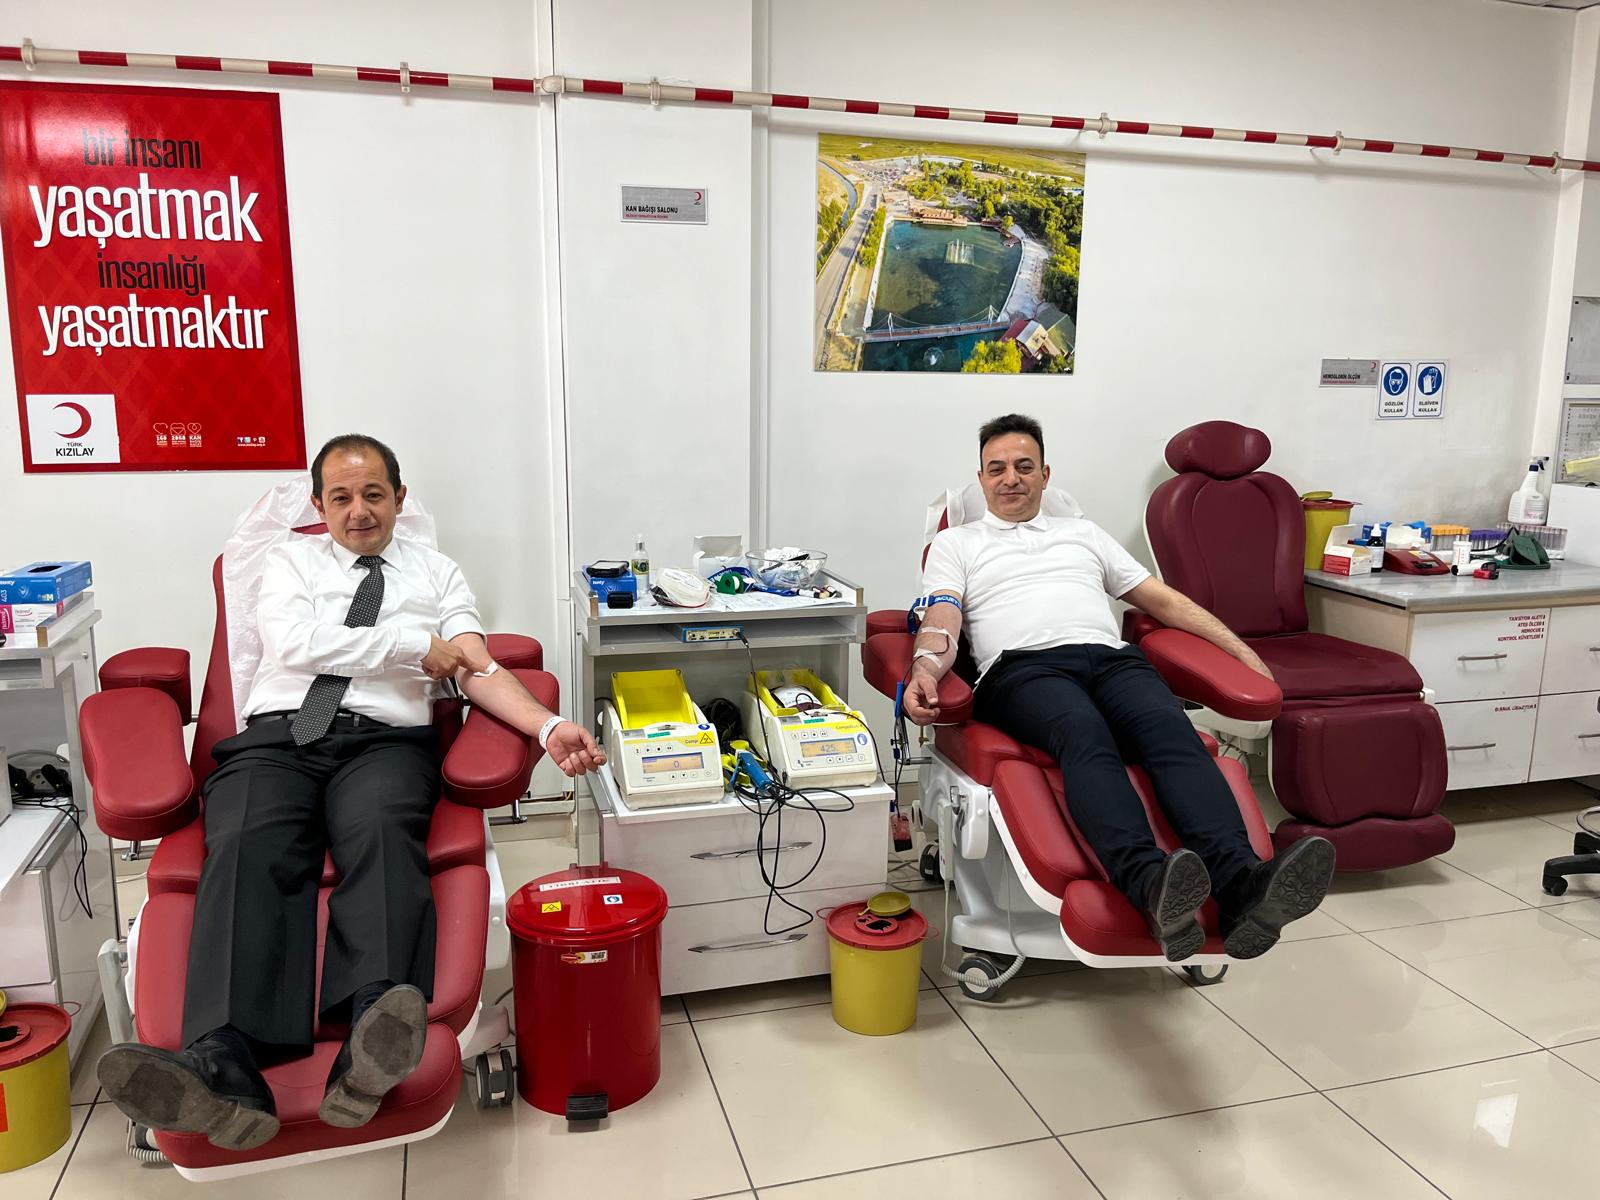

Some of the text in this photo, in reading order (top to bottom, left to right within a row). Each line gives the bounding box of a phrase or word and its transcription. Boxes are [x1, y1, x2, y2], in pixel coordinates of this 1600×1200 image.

[83, 128, 200, 168] bir insanı
[28, 172, 263, 249] yaşatmak
[97, 252, 206, 296] insanlığı
[38, 294, 269, 356] yaşatmaktır
[55, 448, 95, 456] KIZILAY
[820, 744, 836, 752] 425
